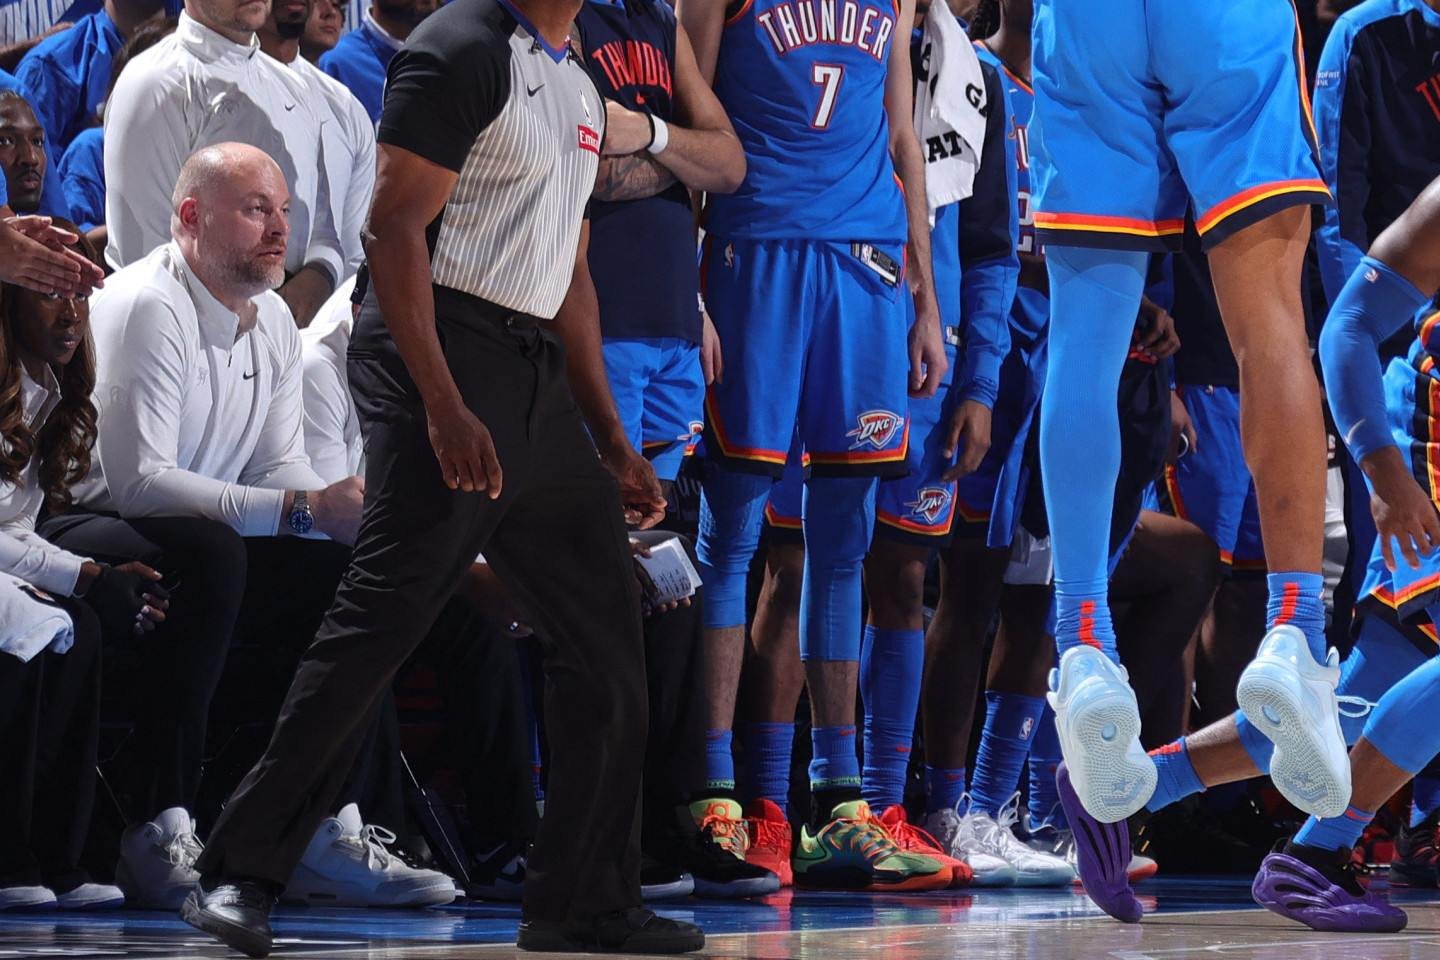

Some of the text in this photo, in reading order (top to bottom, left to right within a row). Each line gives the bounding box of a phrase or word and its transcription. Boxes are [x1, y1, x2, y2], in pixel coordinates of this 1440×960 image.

[812, 62, 844, 131] 7
[859, 417, 890, 441] OKC
[915, 495, 943, 513] OKC
